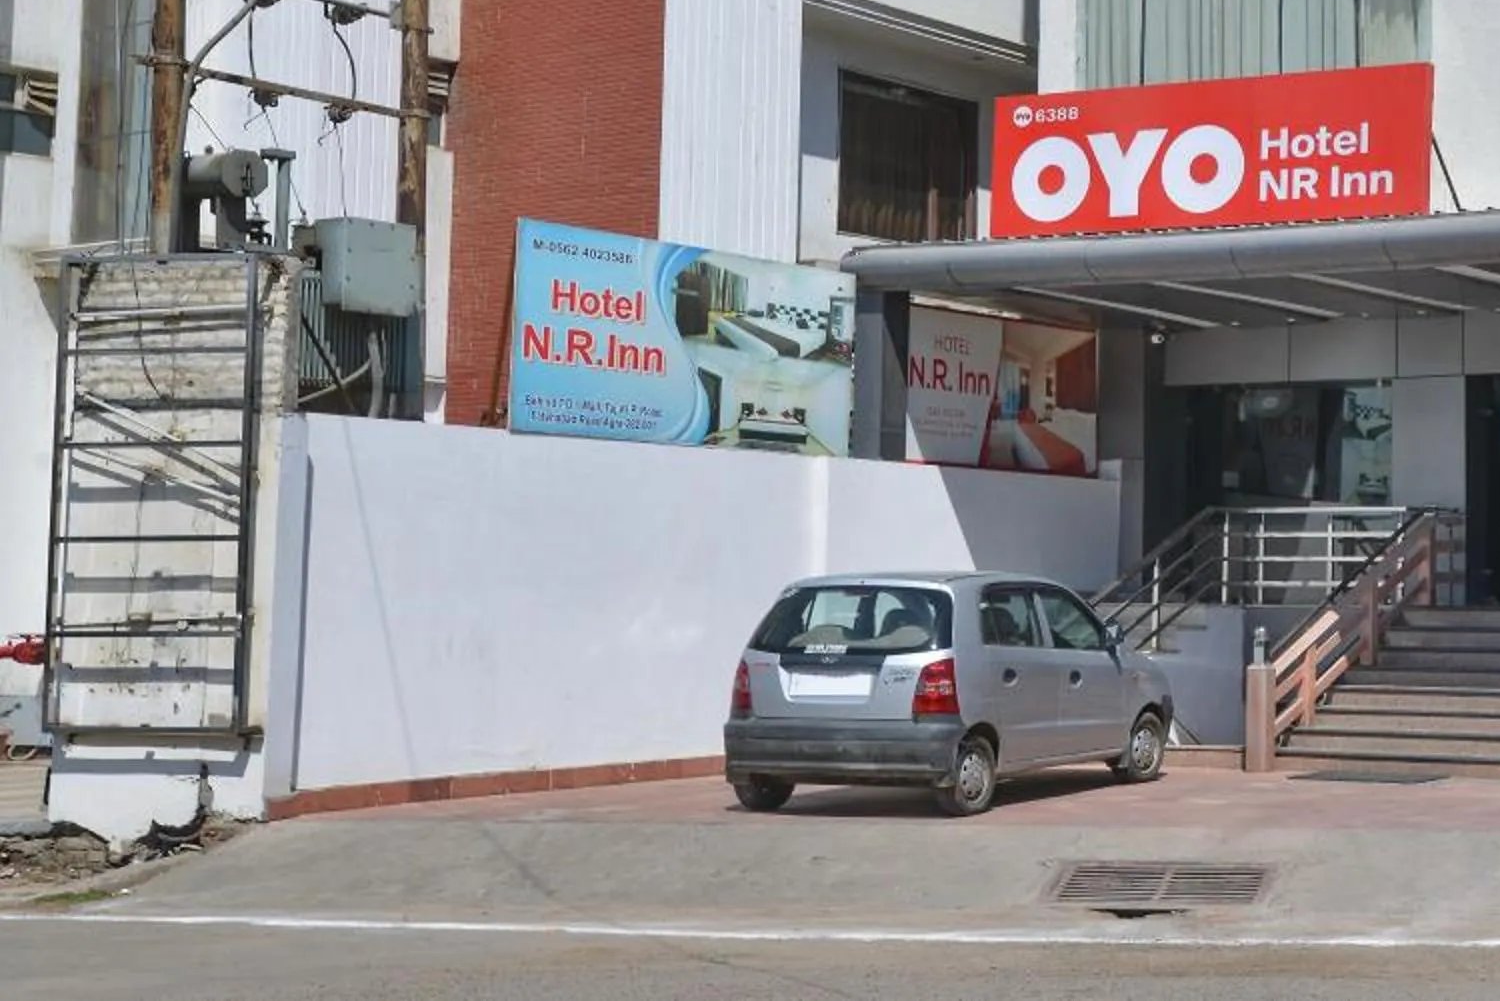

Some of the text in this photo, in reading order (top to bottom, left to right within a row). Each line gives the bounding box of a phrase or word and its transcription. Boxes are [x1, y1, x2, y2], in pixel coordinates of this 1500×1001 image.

[1035, 106, 1079, 123] 6388
[1260, 121, 1370, 161] Hotel
[1011, 124, 1245, 223] OYO
[1259, 165, 1394, 202] NR Inn
[552, 278, 645, 322] Hotel
[934, 334, 973, 355] HOTEL
[958, 362, 990, 396] Inn
